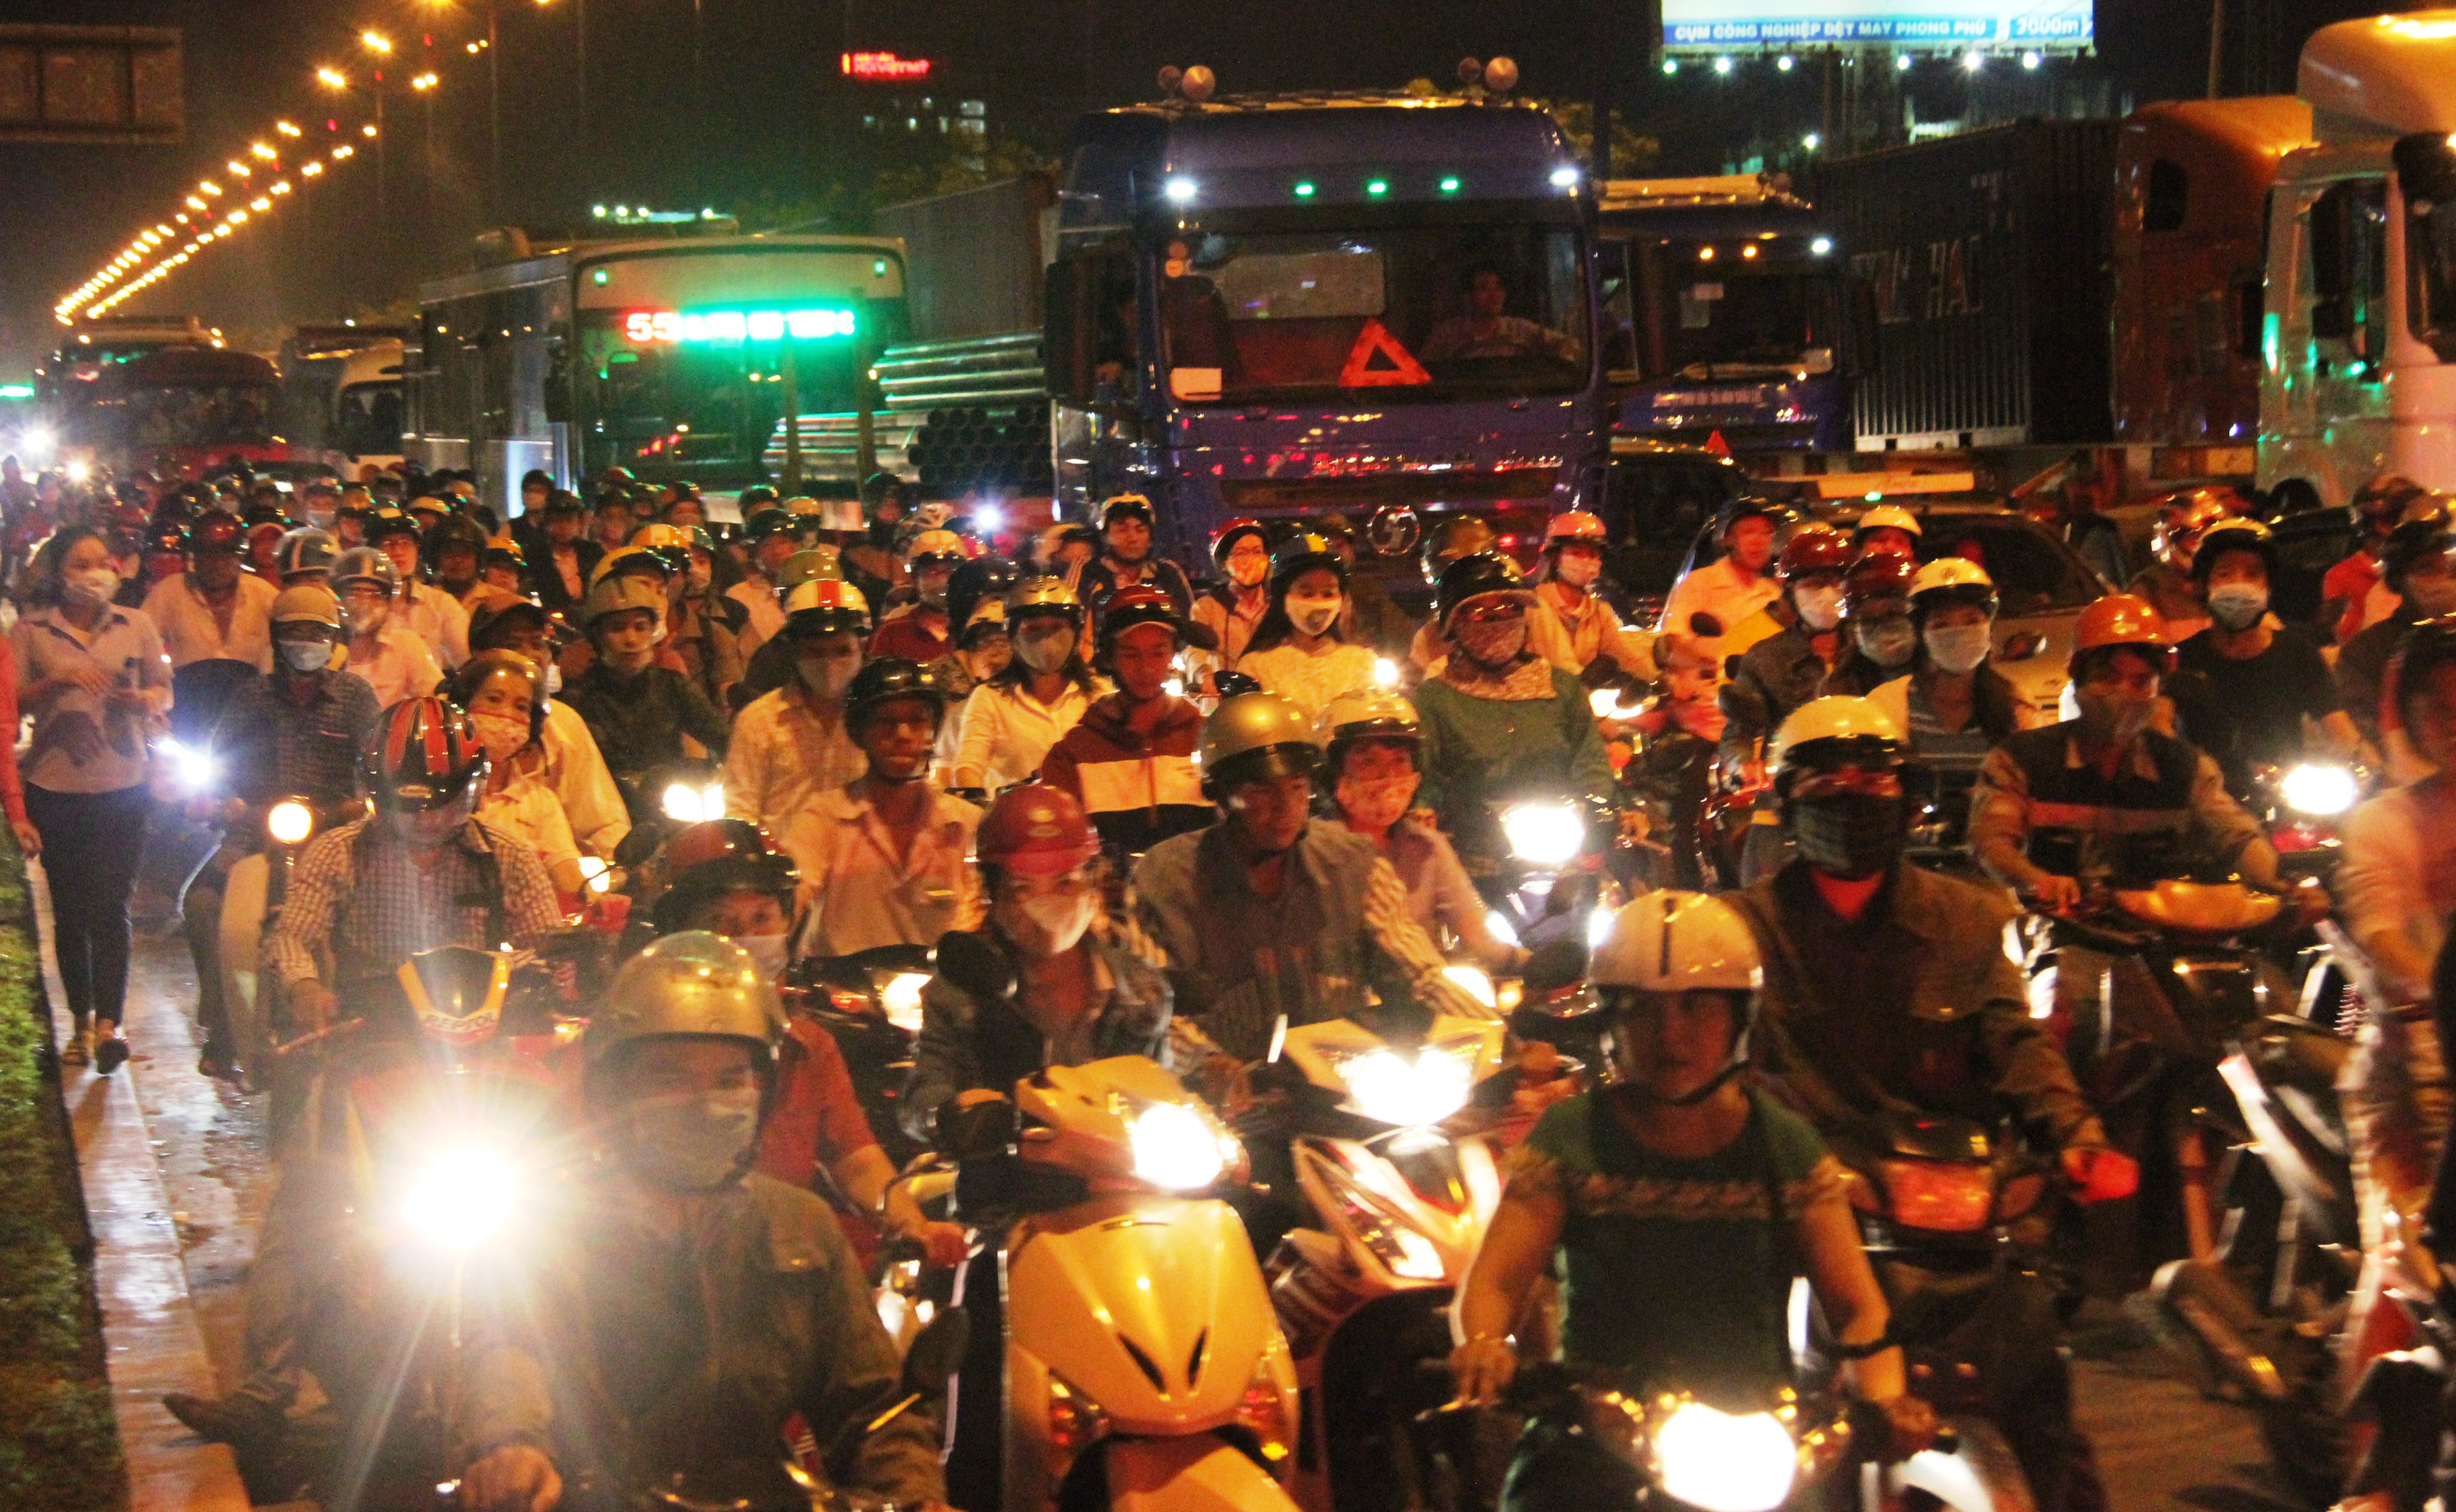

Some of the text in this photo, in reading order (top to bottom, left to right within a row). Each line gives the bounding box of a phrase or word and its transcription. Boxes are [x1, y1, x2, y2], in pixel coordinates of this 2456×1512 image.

[1675, 25, 1710, 42] CỤM
[1713, 23, 1757, 39] CÔNG
[1761, 21, 1821, 39] NGHIỆP
[1859, 22, 1892, 36] MAY
[1897, 21, 1950, 36] PHONG
[1954, 18, 1986, 36] PHÚ
[2017, 18, 2079, 36] 2000m
